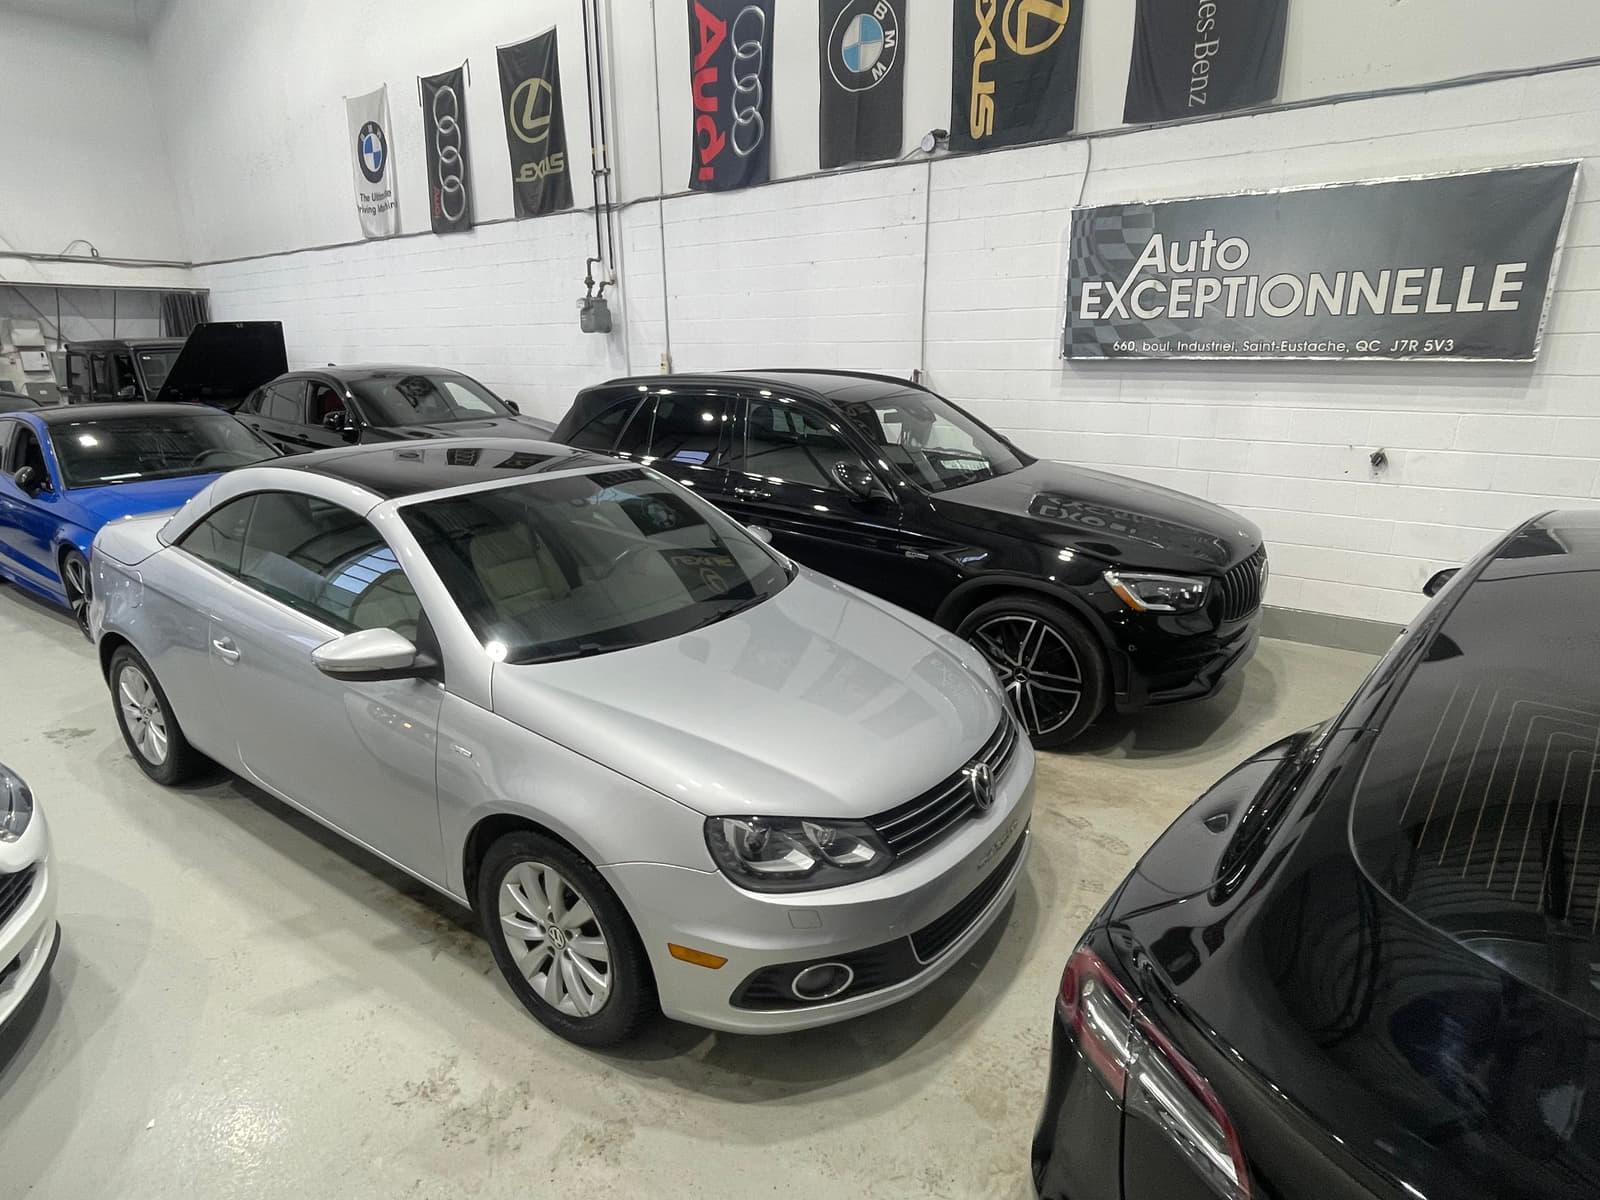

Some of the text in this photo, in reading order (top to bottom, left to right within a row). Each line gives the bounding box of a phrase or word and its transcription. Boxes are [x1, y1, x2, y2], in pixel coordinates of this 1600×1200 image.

[872, 1, 897, 81] BMW
[970, 0, 994, 139] XUS
[1188, 0, 1221, 107] es-Benz
[356, 203, 377, 216] riving
[1130, 229, 1250, 273] Auto
[1079, 262, 1528, 321] EXCEPTIONNELLE
[1142, 340, 1173, 352] boul.
[1355, 339, 1382, 352] QC
[1390, 339, 1419, 352] J7R
[1423, 338, 1455, 352] 5V3
